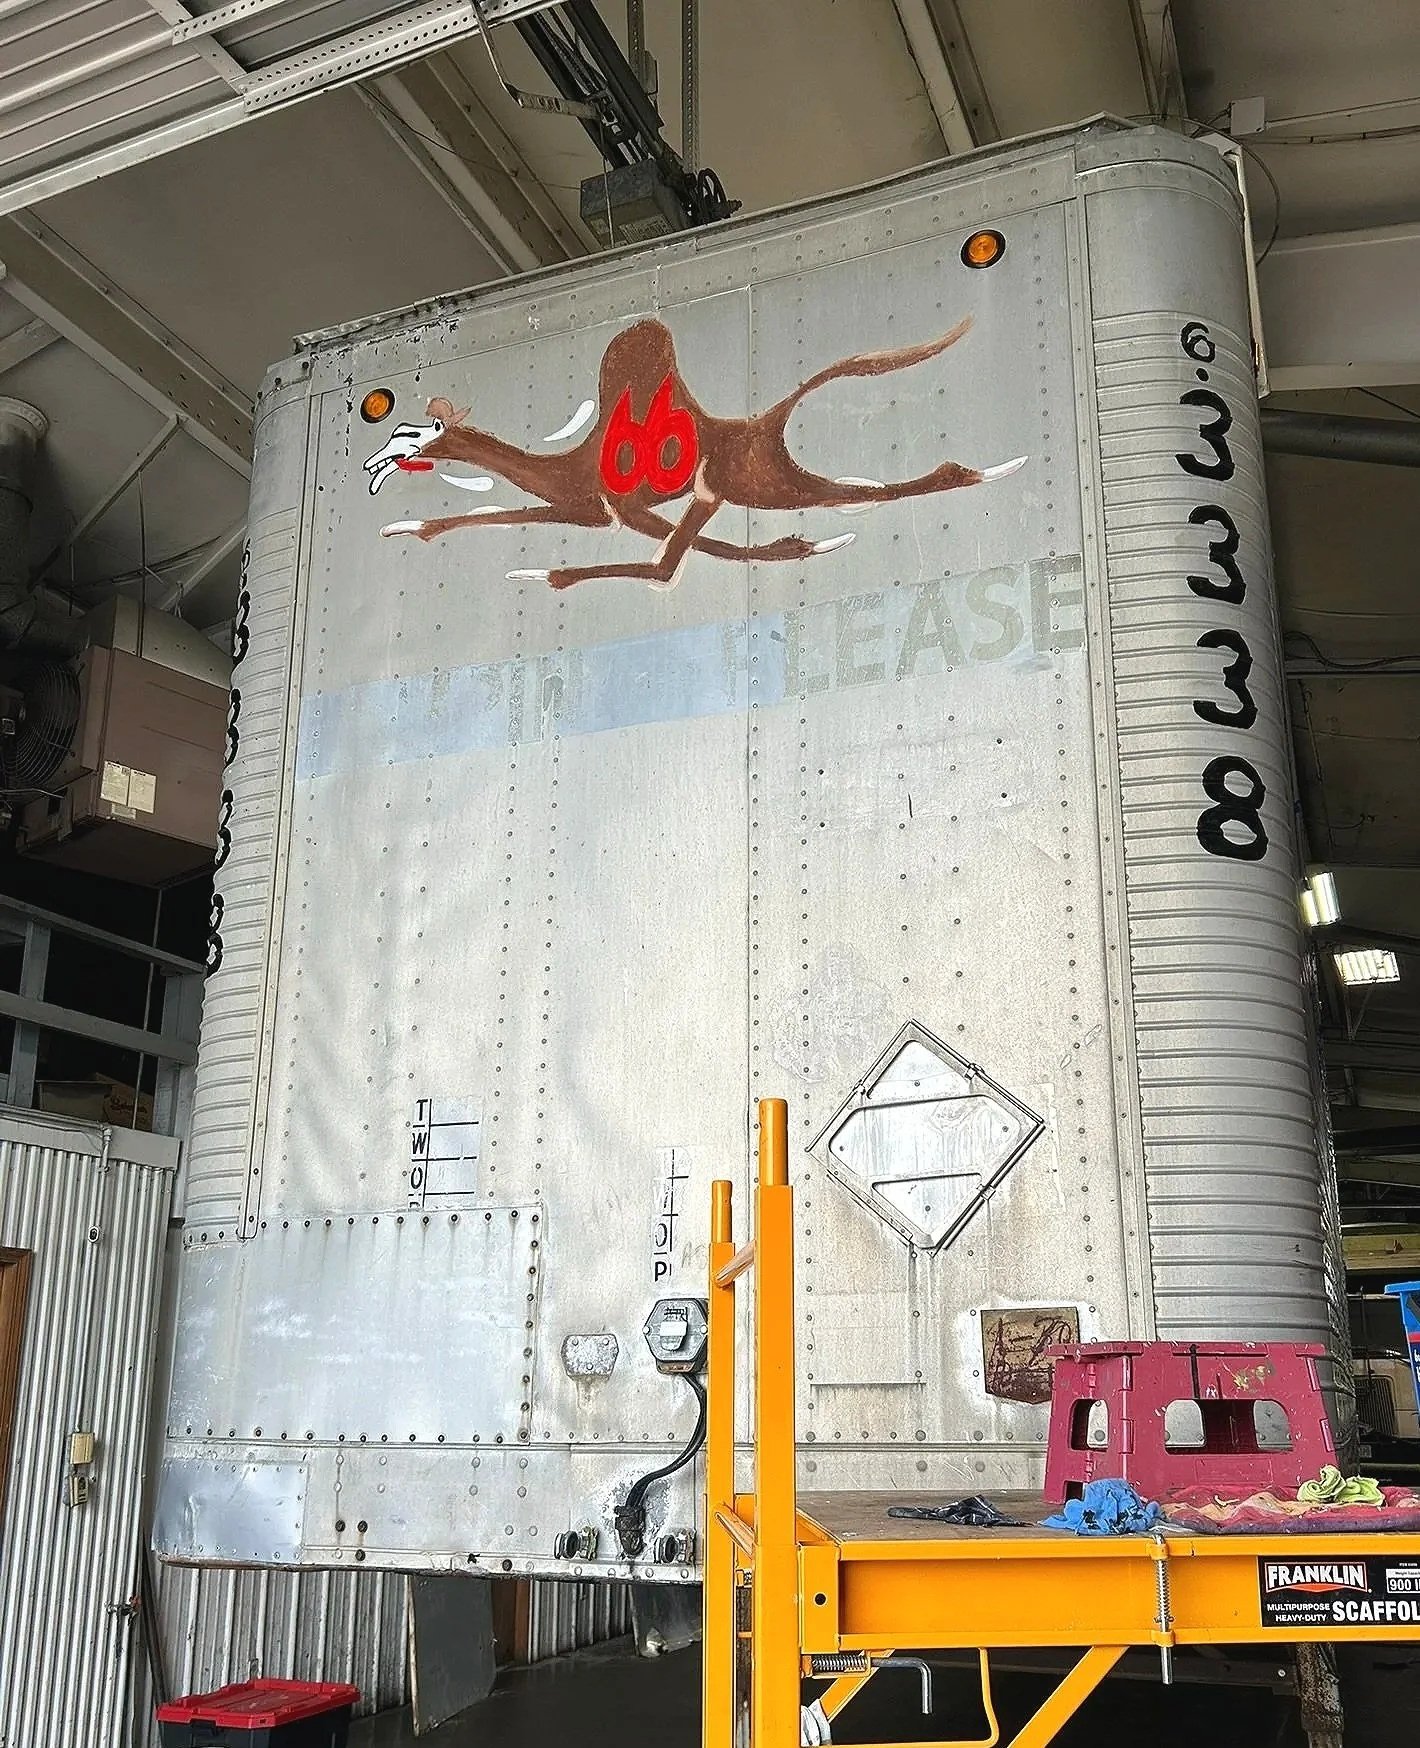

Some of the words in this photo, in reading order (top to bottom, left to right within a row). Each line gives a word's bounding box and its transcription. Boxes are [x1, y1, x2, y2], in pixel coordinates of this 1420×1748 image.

[599, 370, 700, 496] 66
[1267, 1565, 1365, 1588] FRANKLIN
[1389, 1578, 1412, 1591] 900
[1266, 1603, 1331, 1612] MULTIPURPOSE
[1275, 1614, 1327, 1622] HEAVY-DUTY
